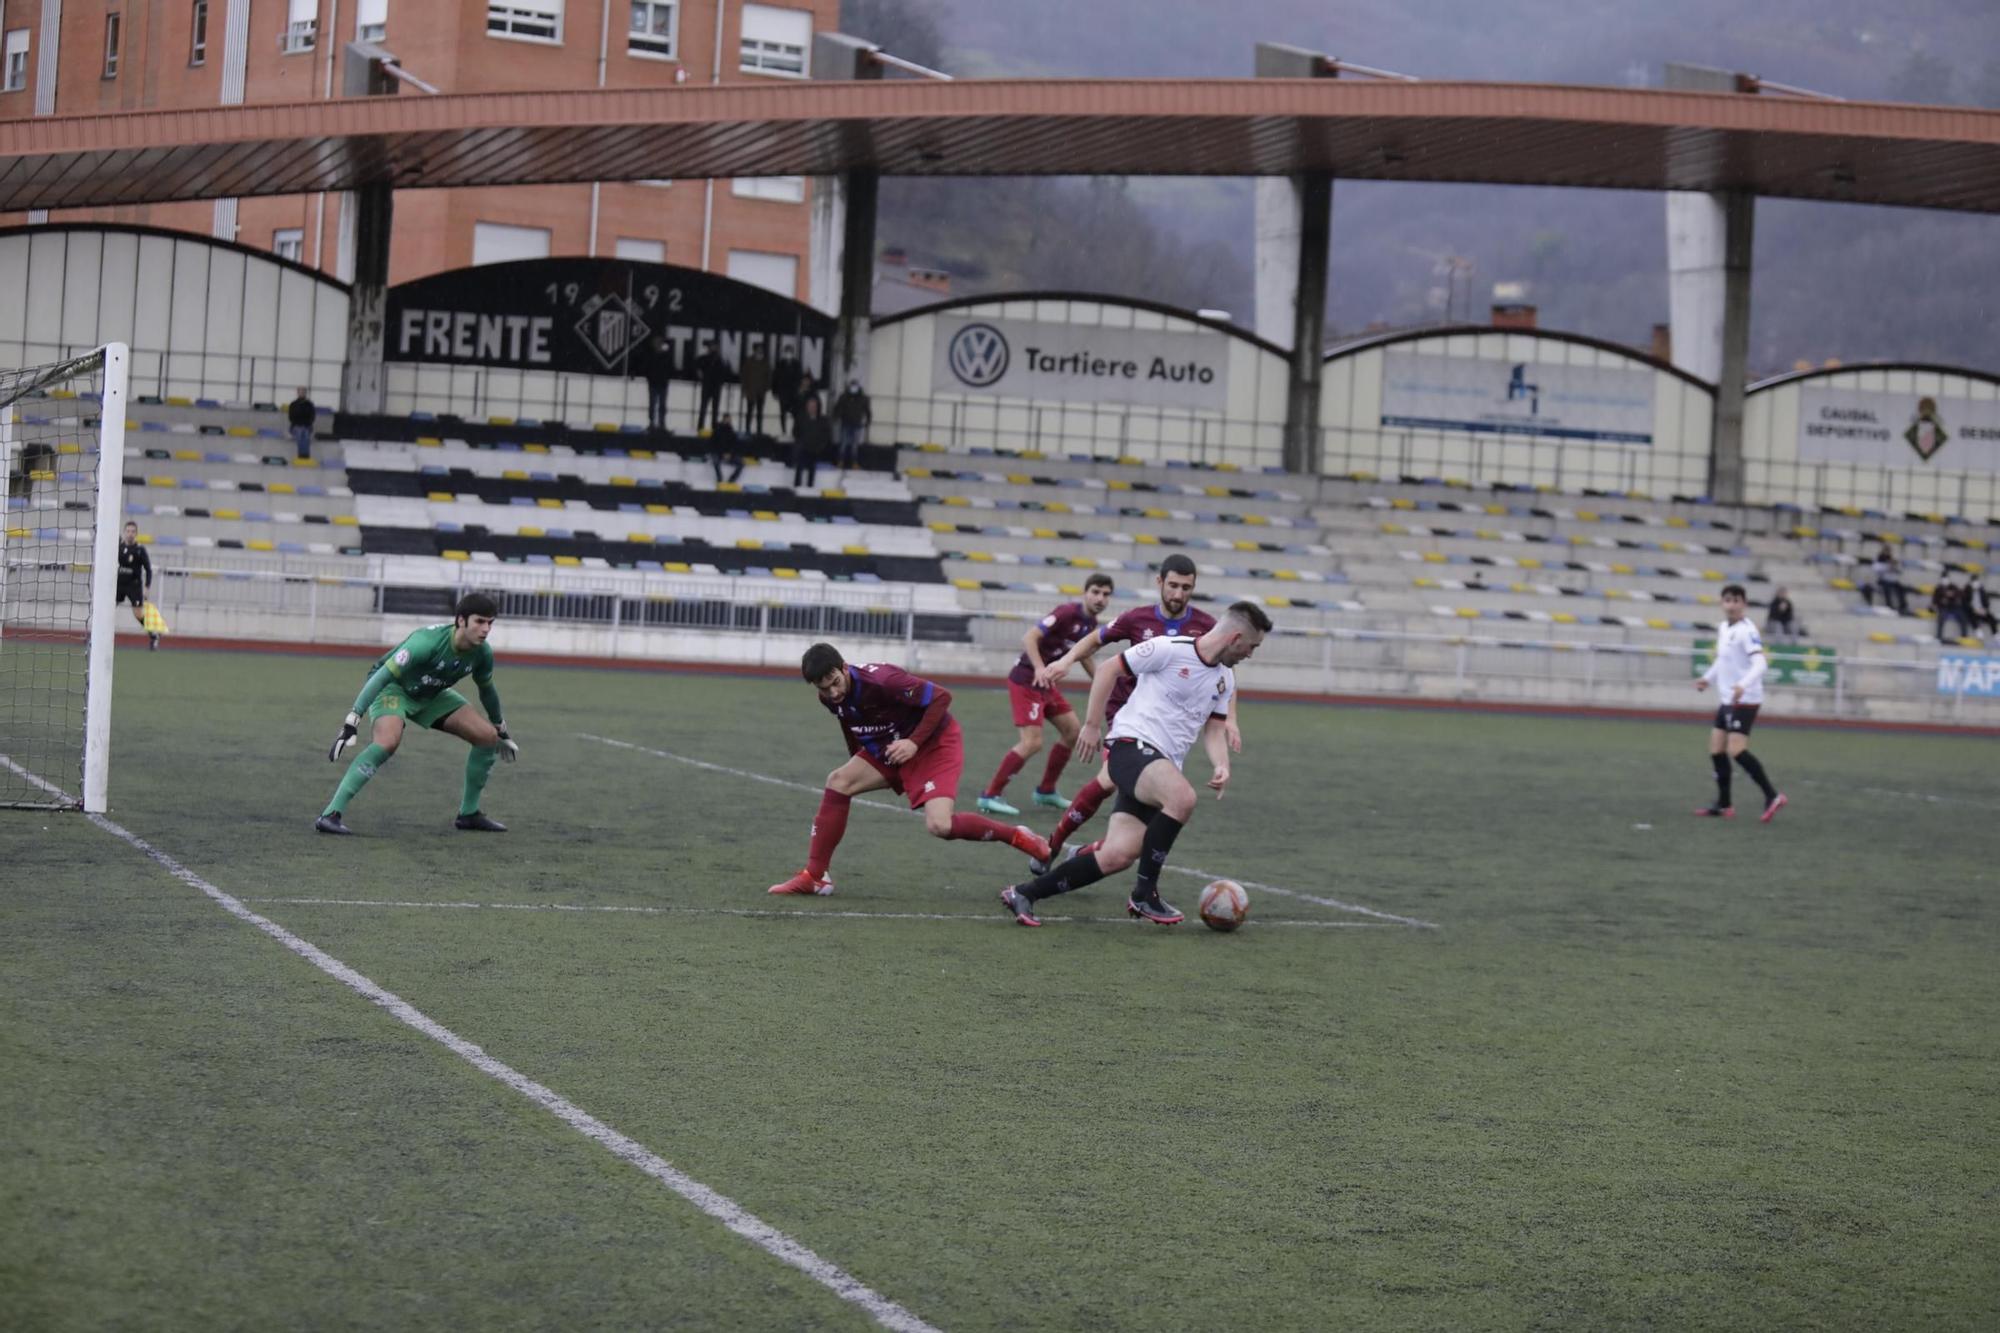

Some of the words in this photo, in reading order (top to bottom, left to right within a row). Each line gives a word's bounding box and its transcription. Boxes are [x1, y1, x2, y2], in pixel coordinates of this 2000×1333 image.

[400, 309, 553, 363] FRENTE
[1025, 347, 1138, 378] Tartiere
[1148, 357, 1214, 384] Auto
